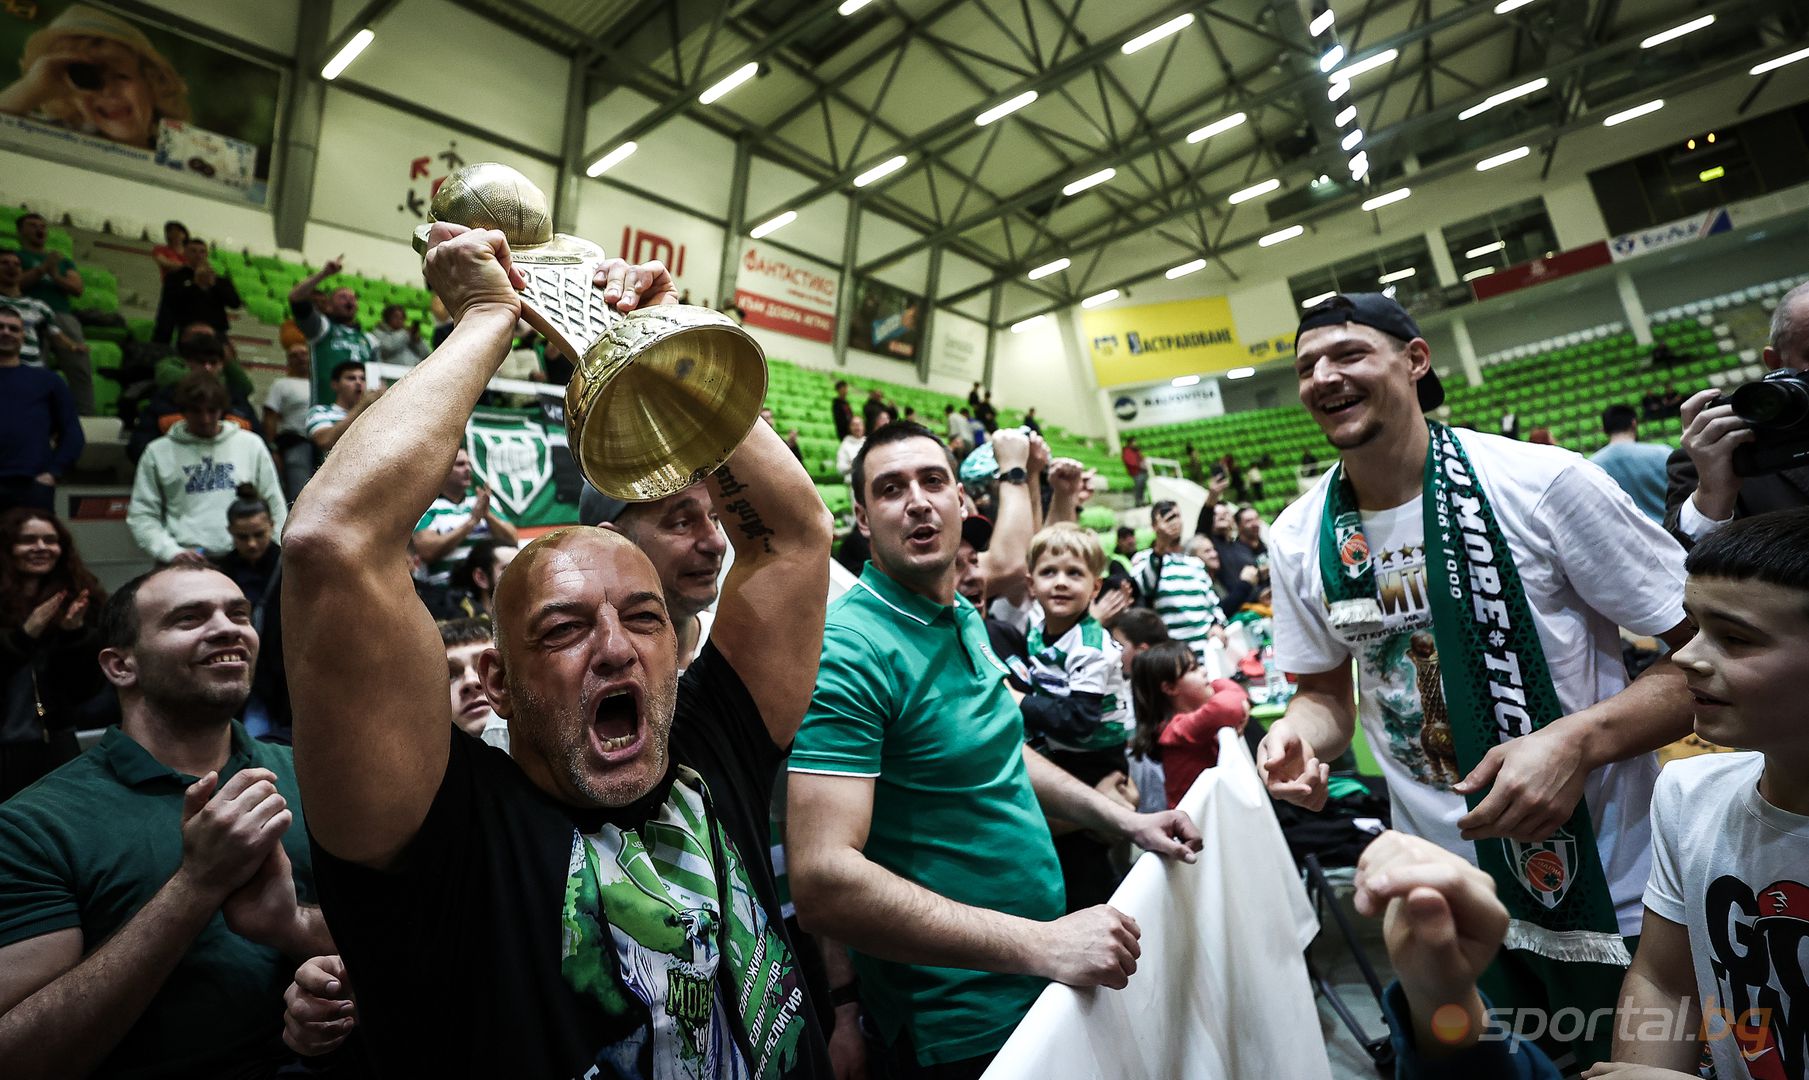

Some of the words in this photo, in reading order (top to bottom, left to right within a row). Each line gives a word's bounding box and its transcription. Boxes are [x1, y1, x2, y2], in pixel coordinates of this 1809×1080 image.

[1452, 491, 1511, 630] MORE
[1483, 650, 1533, 745] TIC
[738, 974, 753, 1019] ЕДИН
[747, 932, 767, 982] ЖИВОТ
[748, 1000, 767, 1048] ЕДИН
[762, 960, 782, 1008] ОТБОР
[754, 1053, 768, 1080] ДНА
[764, 987, 803, 1057] РЕЛИГИЯ
